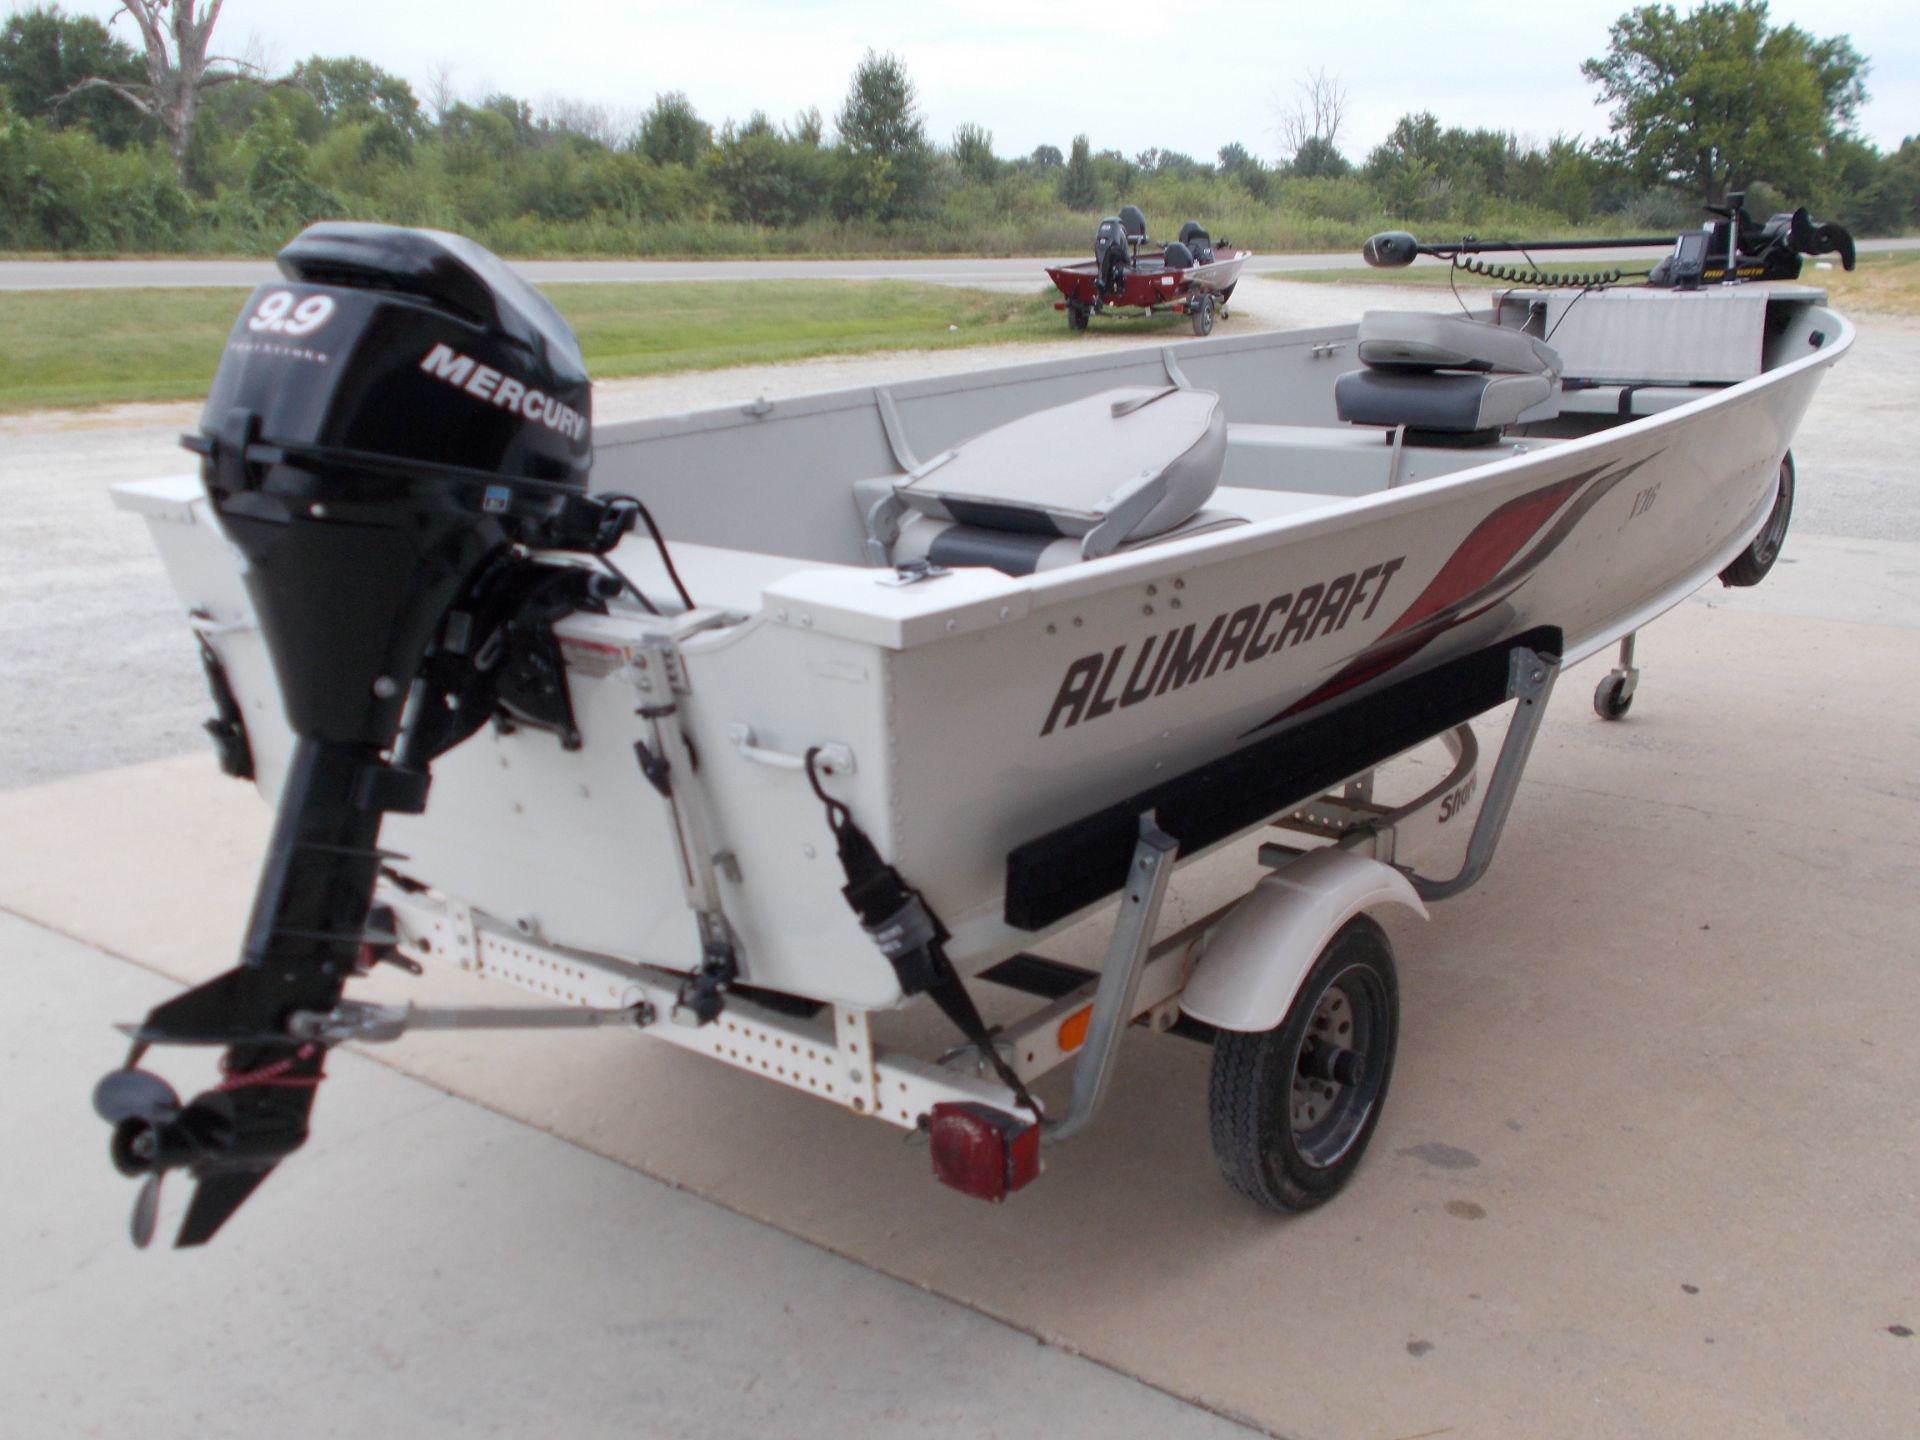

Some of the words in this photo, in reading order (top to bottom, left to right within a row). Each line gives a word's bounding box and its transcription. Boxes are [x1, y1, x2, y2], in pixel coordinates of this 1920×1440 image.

[248, 291, 336, 337] 9.9
[420, 343, 588, 441] MERCURY
[1039, 555, 1407, 737] ALUMACRAFT
